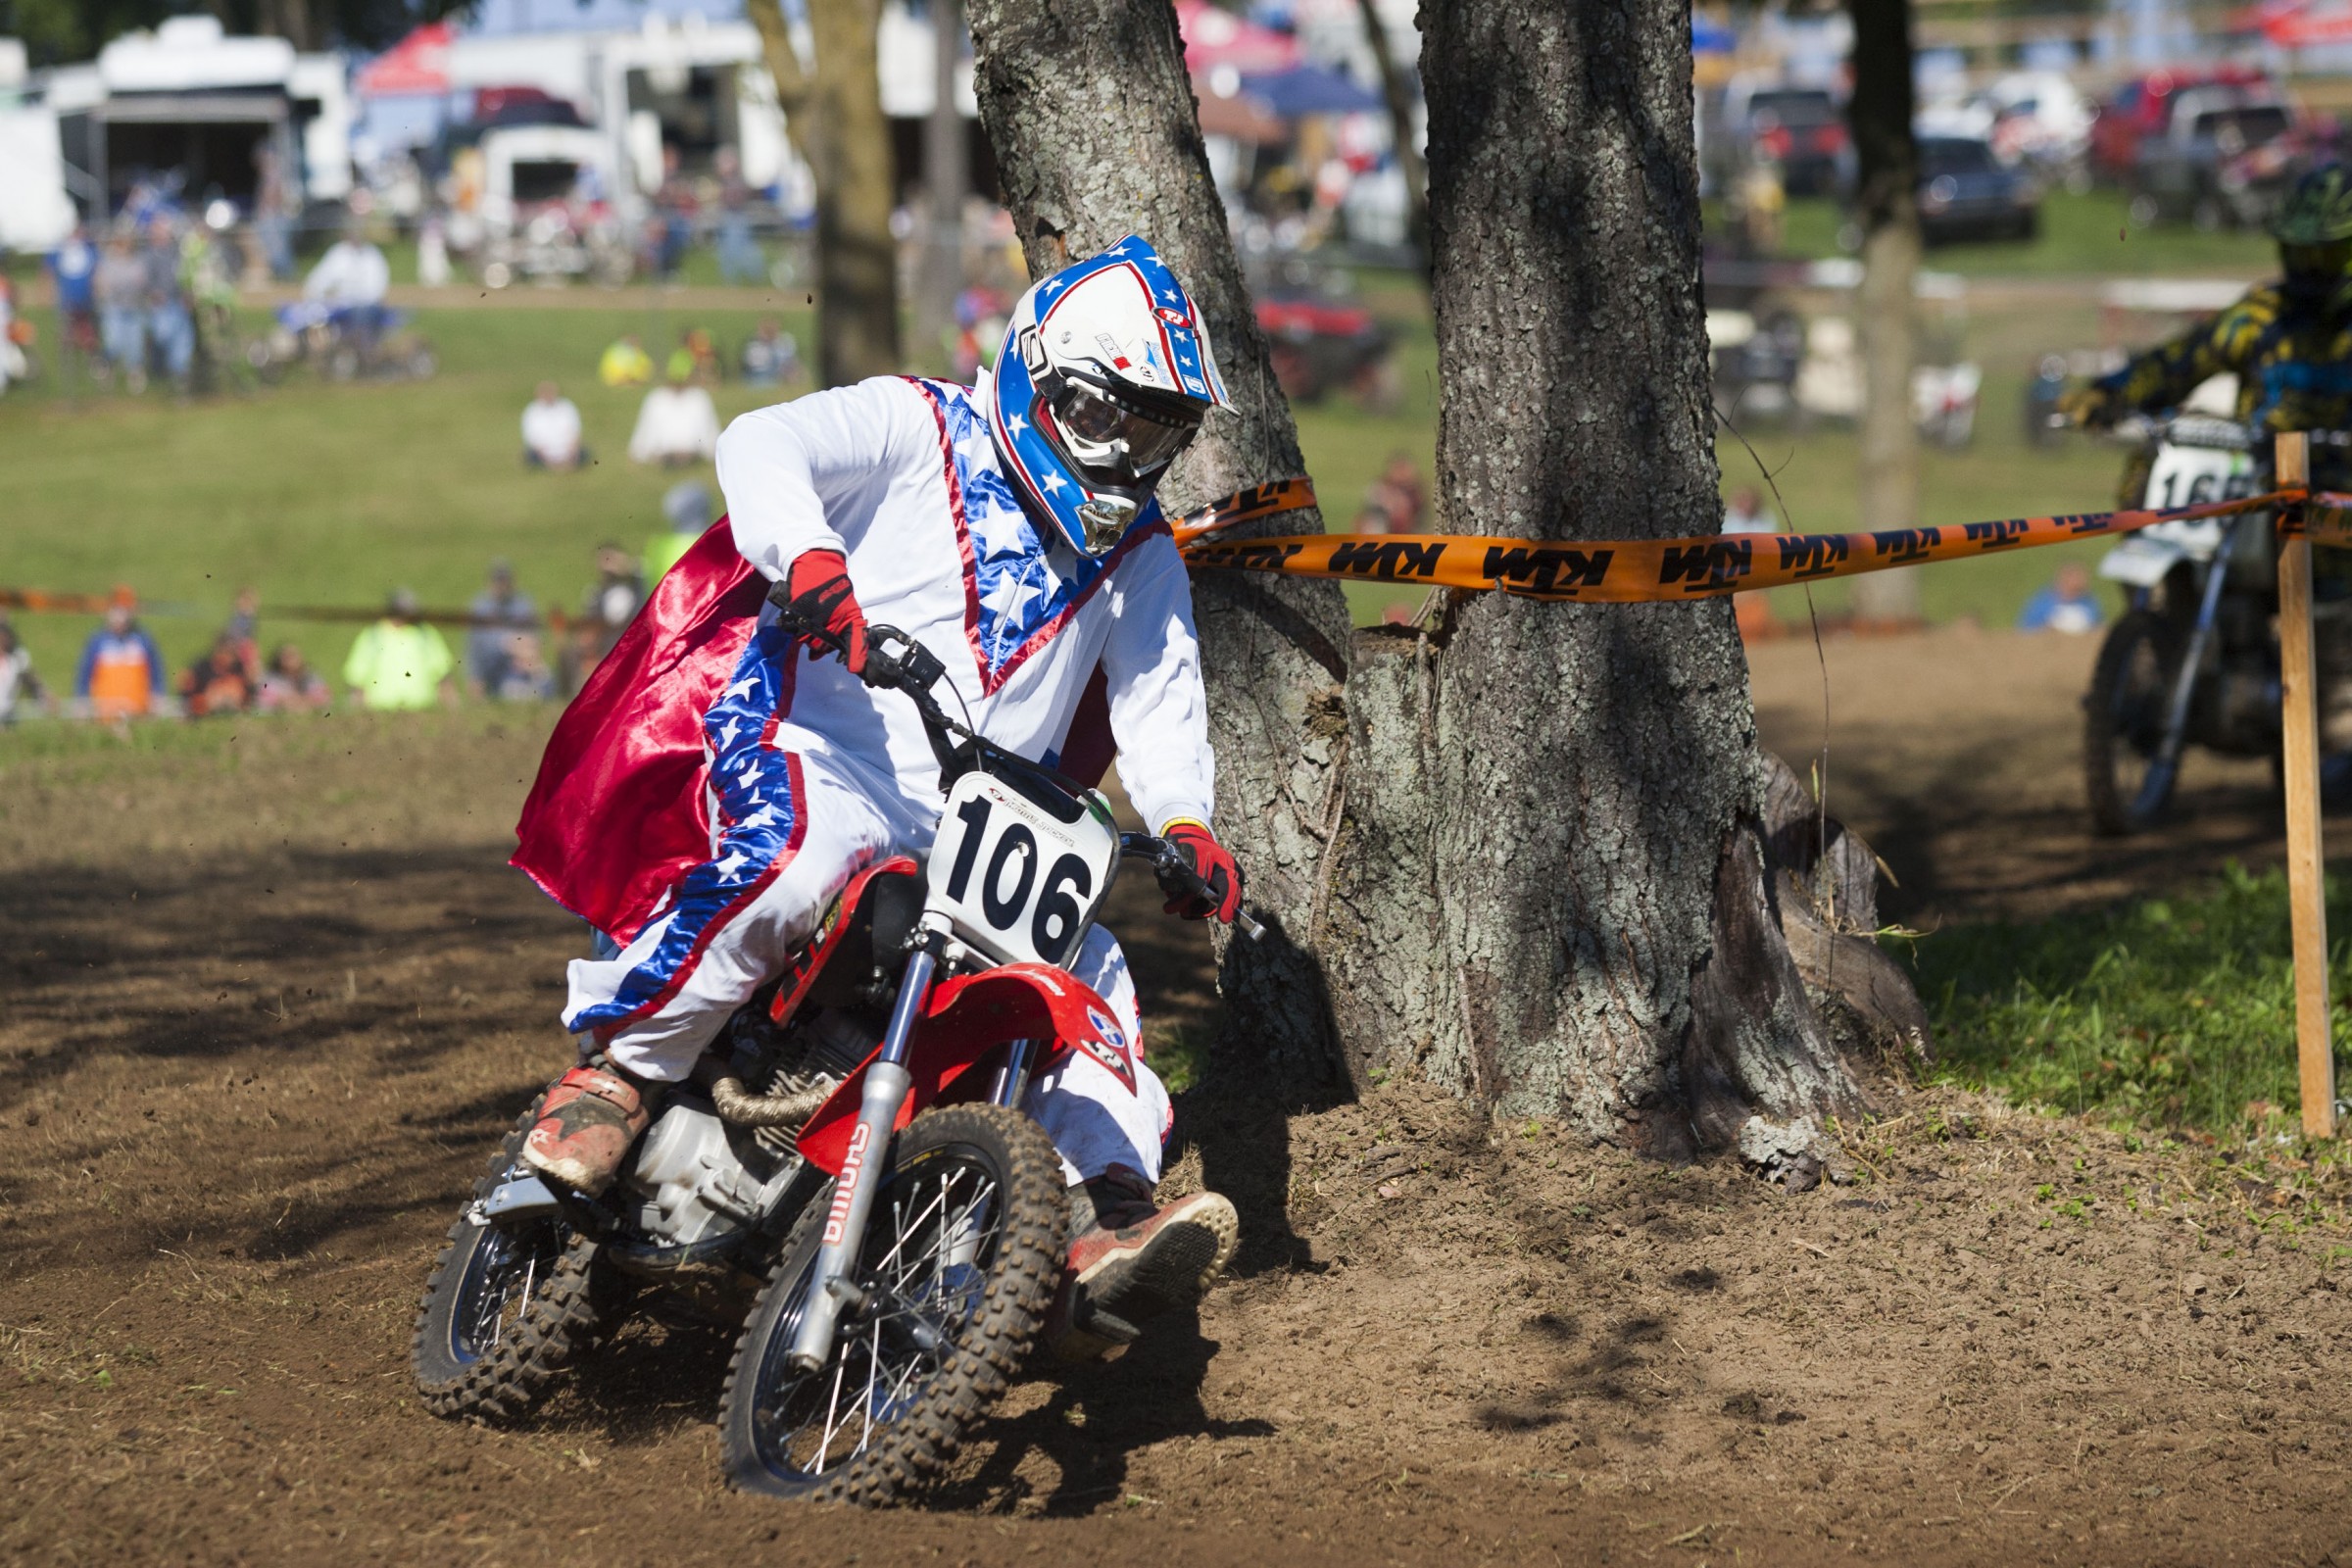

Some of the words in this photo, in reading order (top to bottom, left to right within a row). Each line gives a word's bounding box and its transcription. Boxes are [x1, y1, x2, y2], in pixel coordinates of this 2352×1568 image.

[1328, 542, 1448, 584] KTM
[1483, 546, 1615, 595] KTM
[1658, 539, 1751, 592] KTM
[1775, 534, 1848, 578] KTM
[1871, 526, 1941, 563] KTM
[946, 795, 1092, 964] 106
